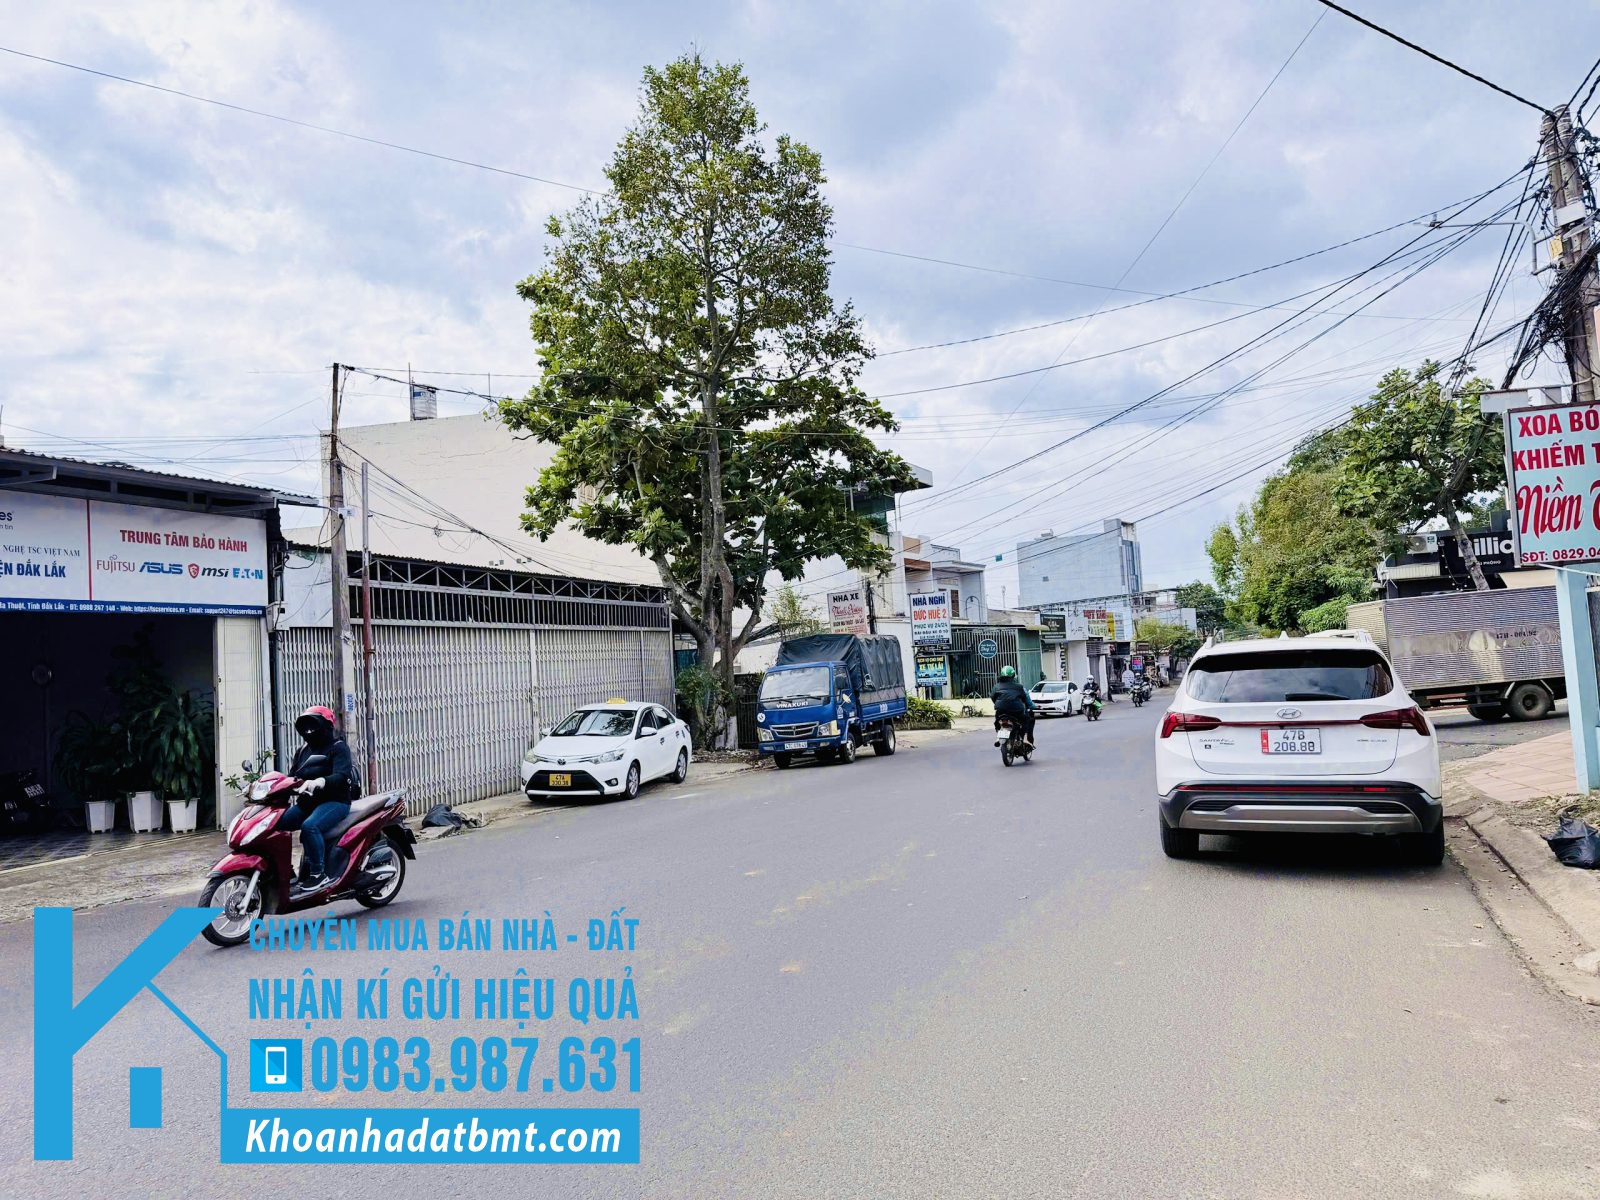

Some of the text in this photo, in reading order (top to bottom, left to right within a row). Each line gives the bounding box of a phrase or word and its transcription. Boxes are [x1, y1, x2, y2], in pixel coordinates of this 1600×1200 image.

[1518, 413, 1562, 437] XOA
[1514, 438, 1585, 471] KHIẾM
[1516, 476, 1584, 539] Niềm
[120, 529, 248, 552] TRUNG TÂM BẢO HÀNH
[3, 544, 25, 555] NGHỆ
[44, 547, 62, 557] VIỆT
[63, 549, 81, 557] NAM
[1522, 554, 1548, 562] SĐT:
[17, 558, 41, 577] ĐẮK
[44, 560, 67, 578] LẮK
[96, 554, 136, 573] FUJITSU
[139, 561, 184, 575] ASUS
[201, 567, 230, 578] msi
[942, 608, 947, 619] 2
[776, 701, 809, 709] VINAXUKI
[1282, 730, 1305, 740] 47B
[1274, 741, 1315, 752] 208.88
